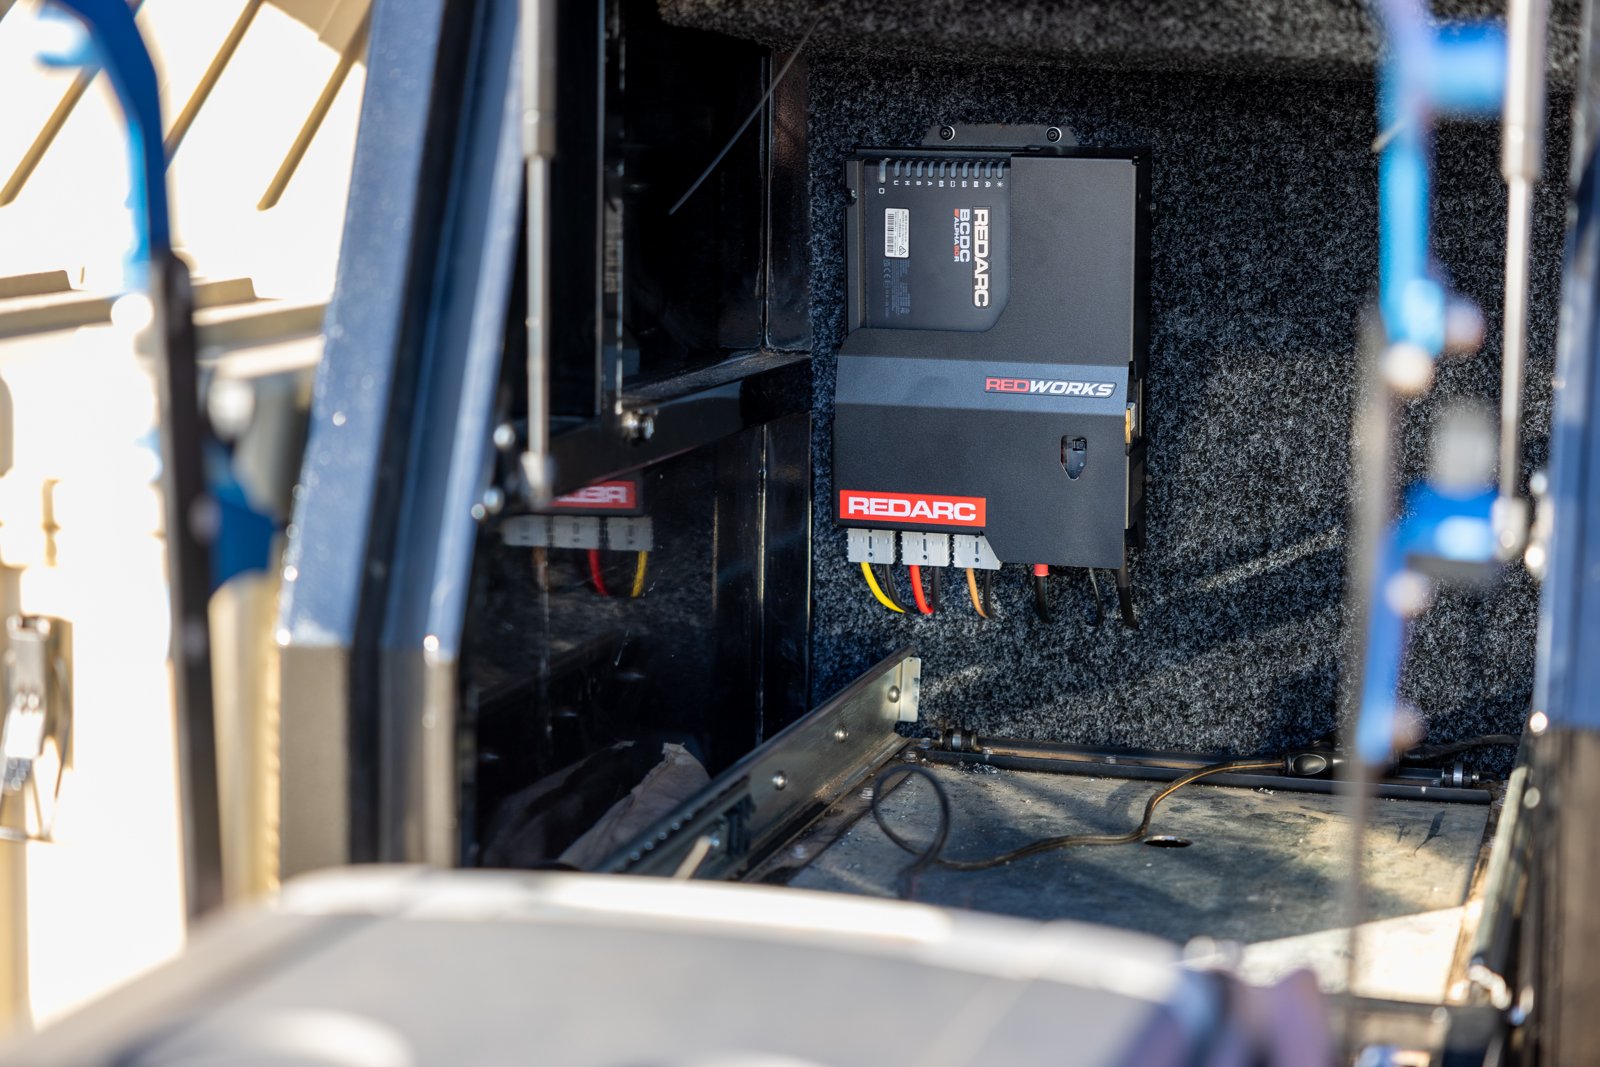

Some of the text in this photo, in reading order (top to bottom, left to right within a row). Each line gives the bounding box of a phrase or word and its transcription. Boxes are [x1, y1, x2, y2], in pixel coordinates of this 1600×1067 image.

[960, 208, 970, 263] BCDC
[974, 209, 989, 307] REDARC
[985, 377, 1114, 397] REDWORKS
[848, 496, 977, 521] REDARC
